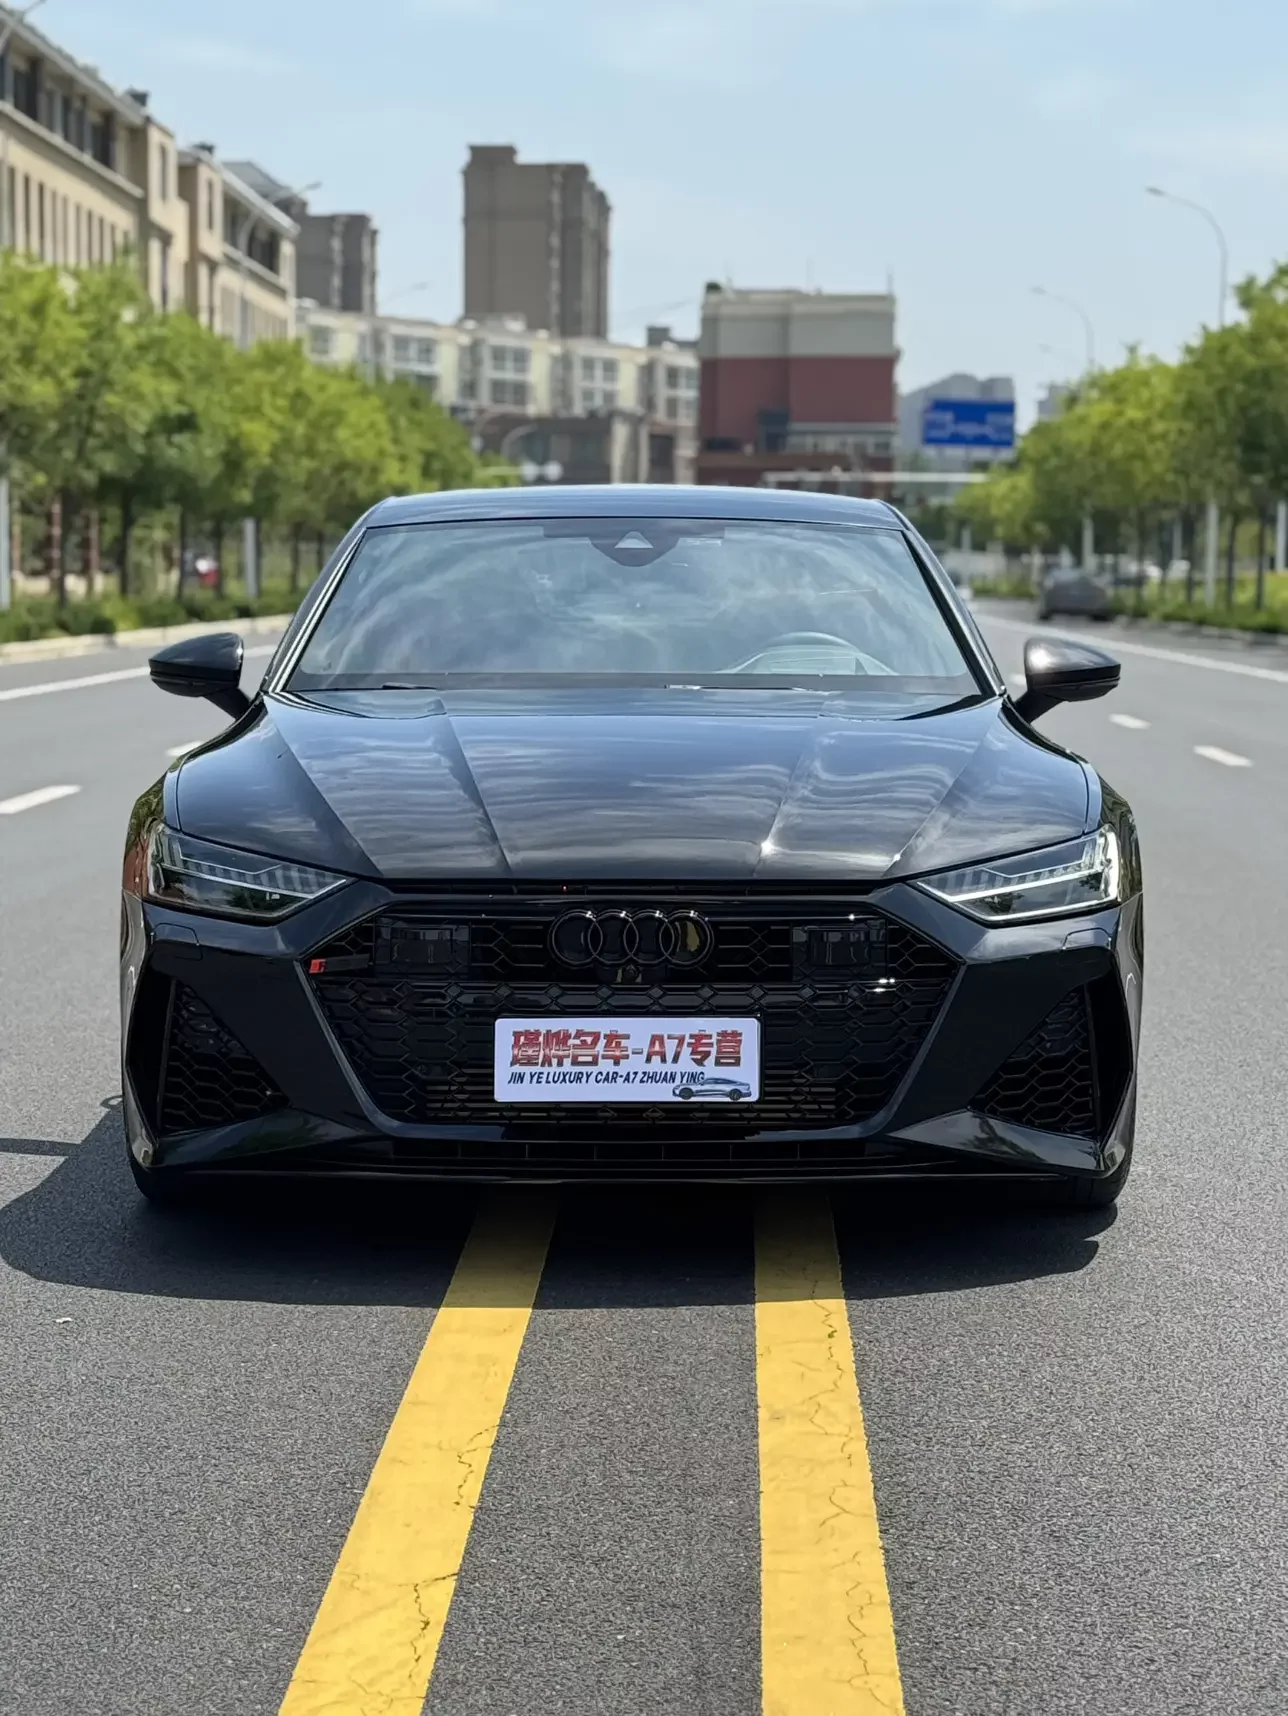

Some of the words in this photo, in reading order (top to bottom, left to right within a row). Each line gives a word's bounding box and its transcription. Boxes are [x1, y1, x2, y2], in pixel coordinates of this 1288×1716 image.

[508, 1071, 526, 1084] JIN
[529, 1071, 545, 1084] YE
[546, 1071, 593, 1084] LUXURY
[595, 1071, 638, 1084] CAR-A7
[640, 1071, 676, 1084] ZHUAN
[679, 1071, 705, 1085] YING
